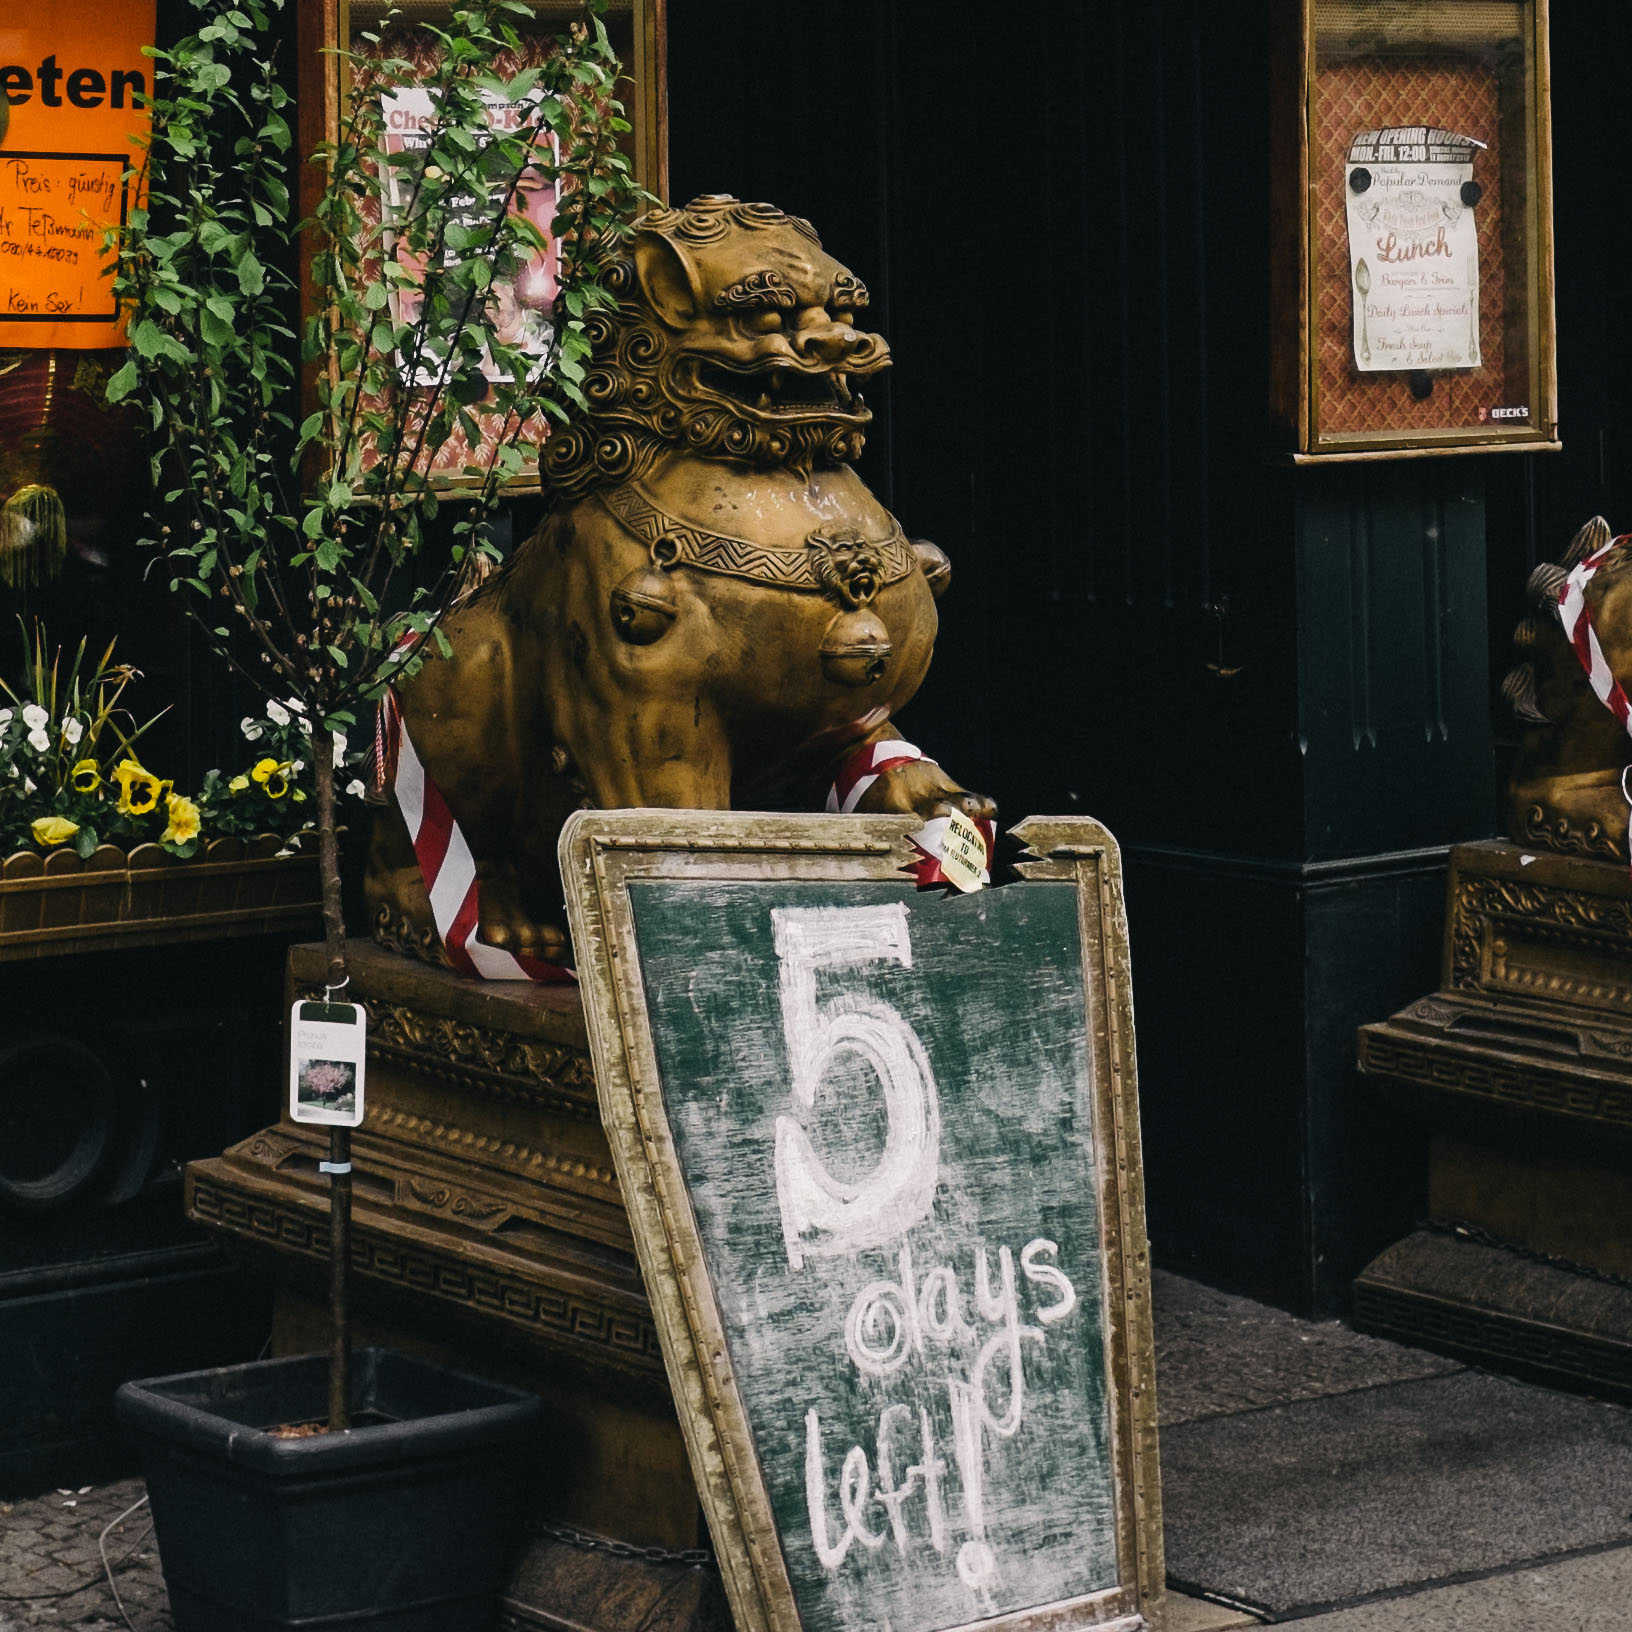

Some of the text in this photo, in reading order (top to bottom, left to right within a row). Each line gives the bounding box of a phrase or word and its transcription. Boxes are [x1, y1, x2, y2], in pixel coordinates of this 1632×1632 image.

[1379, 127, 1427, 145] OPENING
[1398, 145, 1427, 162] 12:00
[1372, 171, 1463, 193] Popular Demand
[1376, 226, 1454, 264] Lunch
[960, 841, 970, 856] TO
[770, 901, 939, 1271] 5
[844, 1237, 1078, 1438] days
